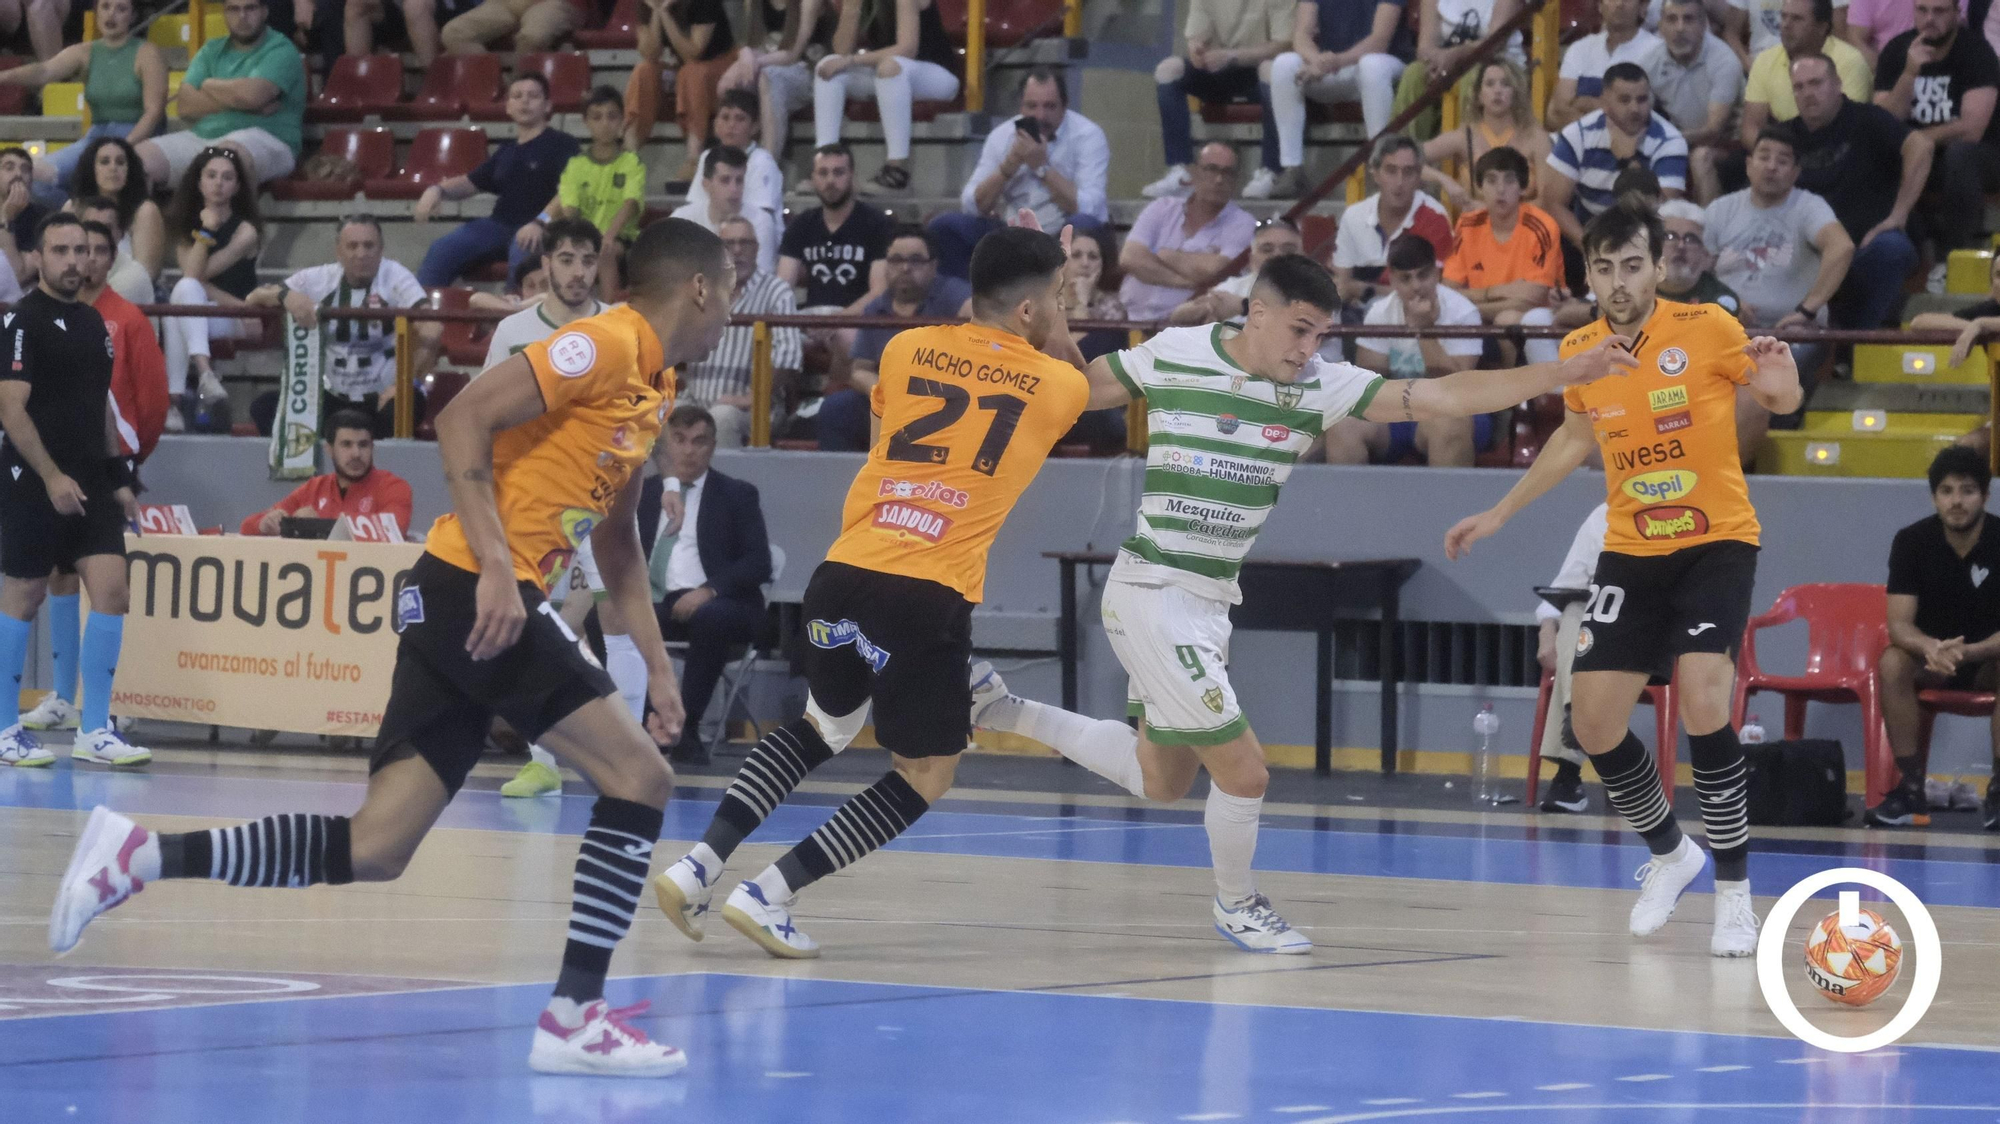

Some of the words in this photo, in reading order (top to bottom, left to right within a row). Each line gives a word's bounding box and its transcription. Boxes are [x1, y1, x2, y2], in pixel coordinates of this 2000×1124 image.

[911, 347, 973, 378] NACHO
[976, 363, 1041, 396] GÓMEZ
[1652, 388, 1686, 407] JARAMA
[885, 375, 1028, 477] 21
[1658, 418, 1690, 432] BARRAL
[1210, 458, 1269, 476] PATRIMONIO
[1612, 439, 1686, 471] uvesa
[1632, 474, 1683, 500] aspil
[878, 504, 944, 538] SANDUA
[1165, 498, 1246, 522] Mezquita-
[1185, 533, 1217, 546] Corazón
[1188, 518, 1250, 539] Catedral
[1581, 584, 1626, 624] 20
[811, 622, 831, 645] IT
[177, 650, 278, 677] avanzamos
[284, 652, 300, 678] al
[307, 653, 361, 682] futuro
[1175, 644, 1207, 682] 9
[326, 711, 383, 726] #ESTAM
[1804, 955, 1847, 996] oma
